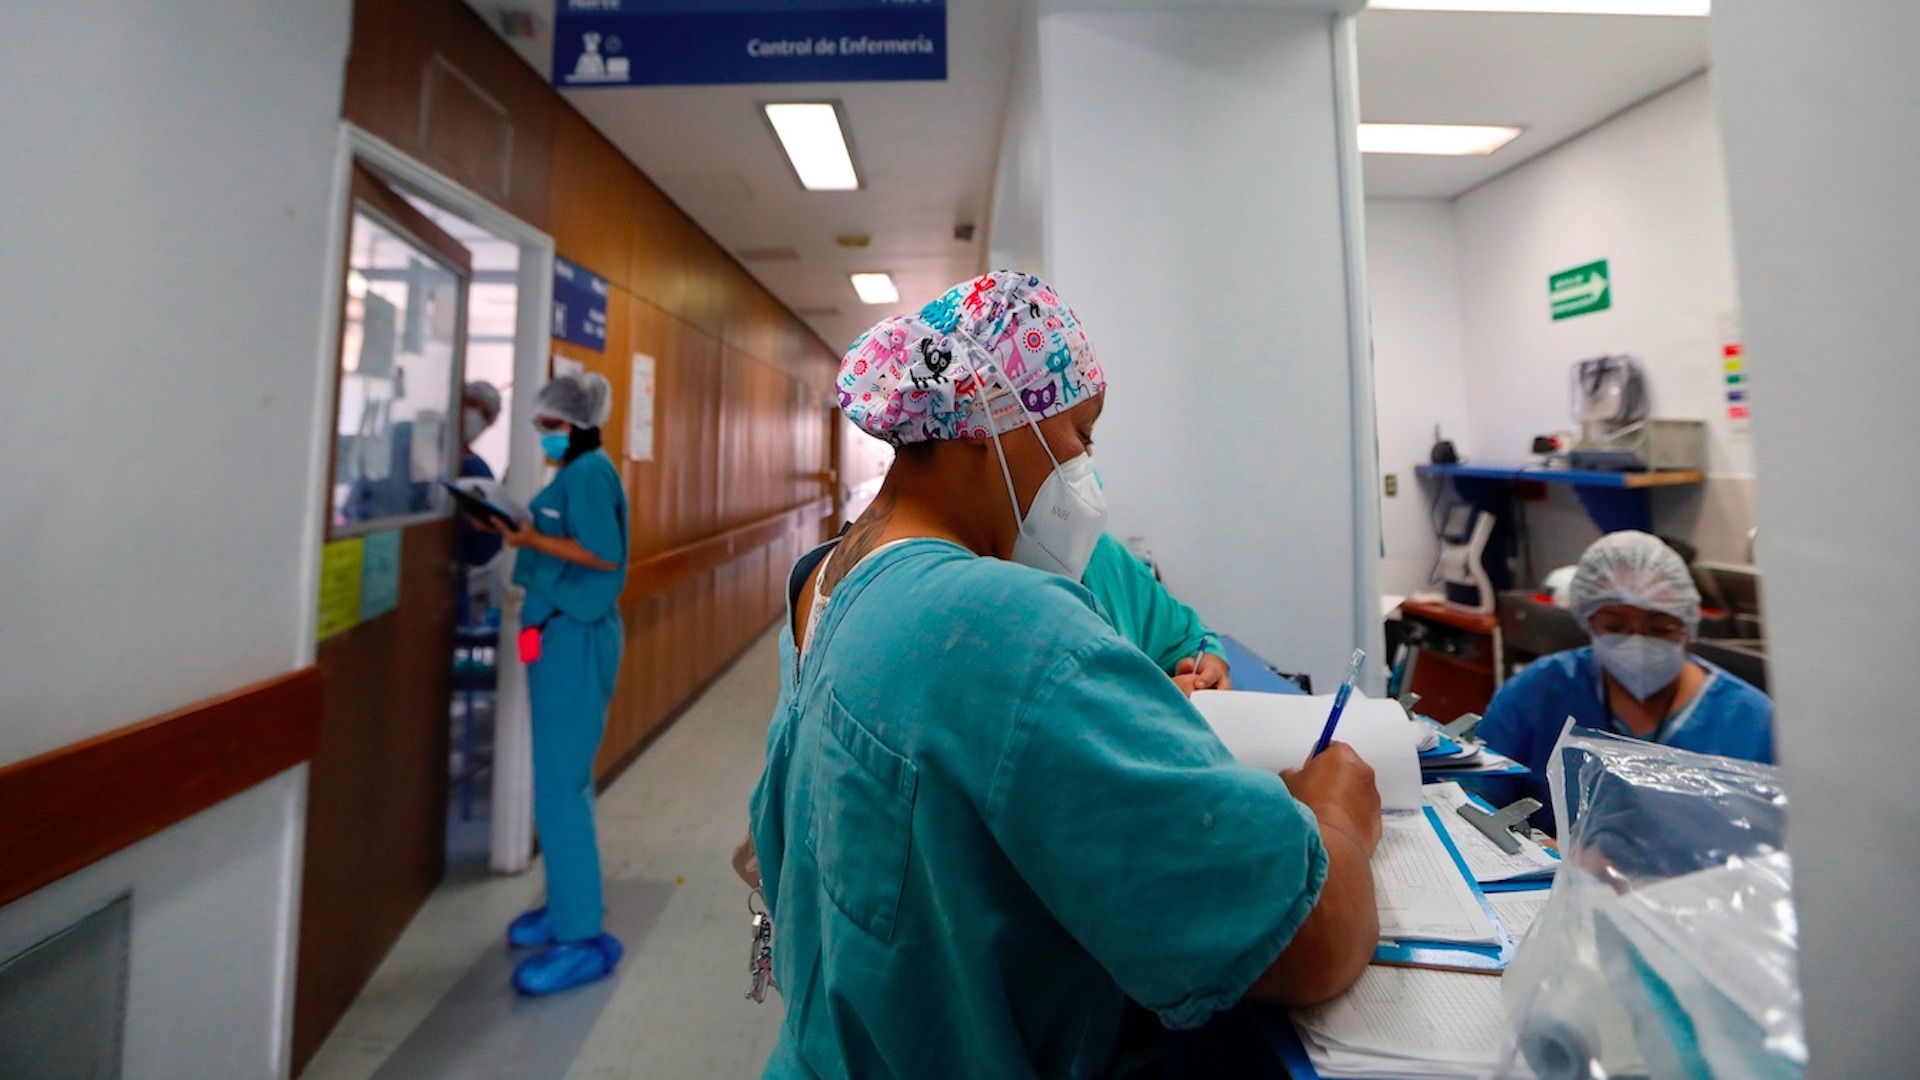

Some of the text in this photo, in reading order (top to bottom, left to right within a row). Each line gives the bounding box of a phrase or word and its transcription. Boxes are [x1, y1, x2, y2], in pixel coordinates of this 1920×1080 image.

[746, 33, 934, 58] Control de Enfermería
